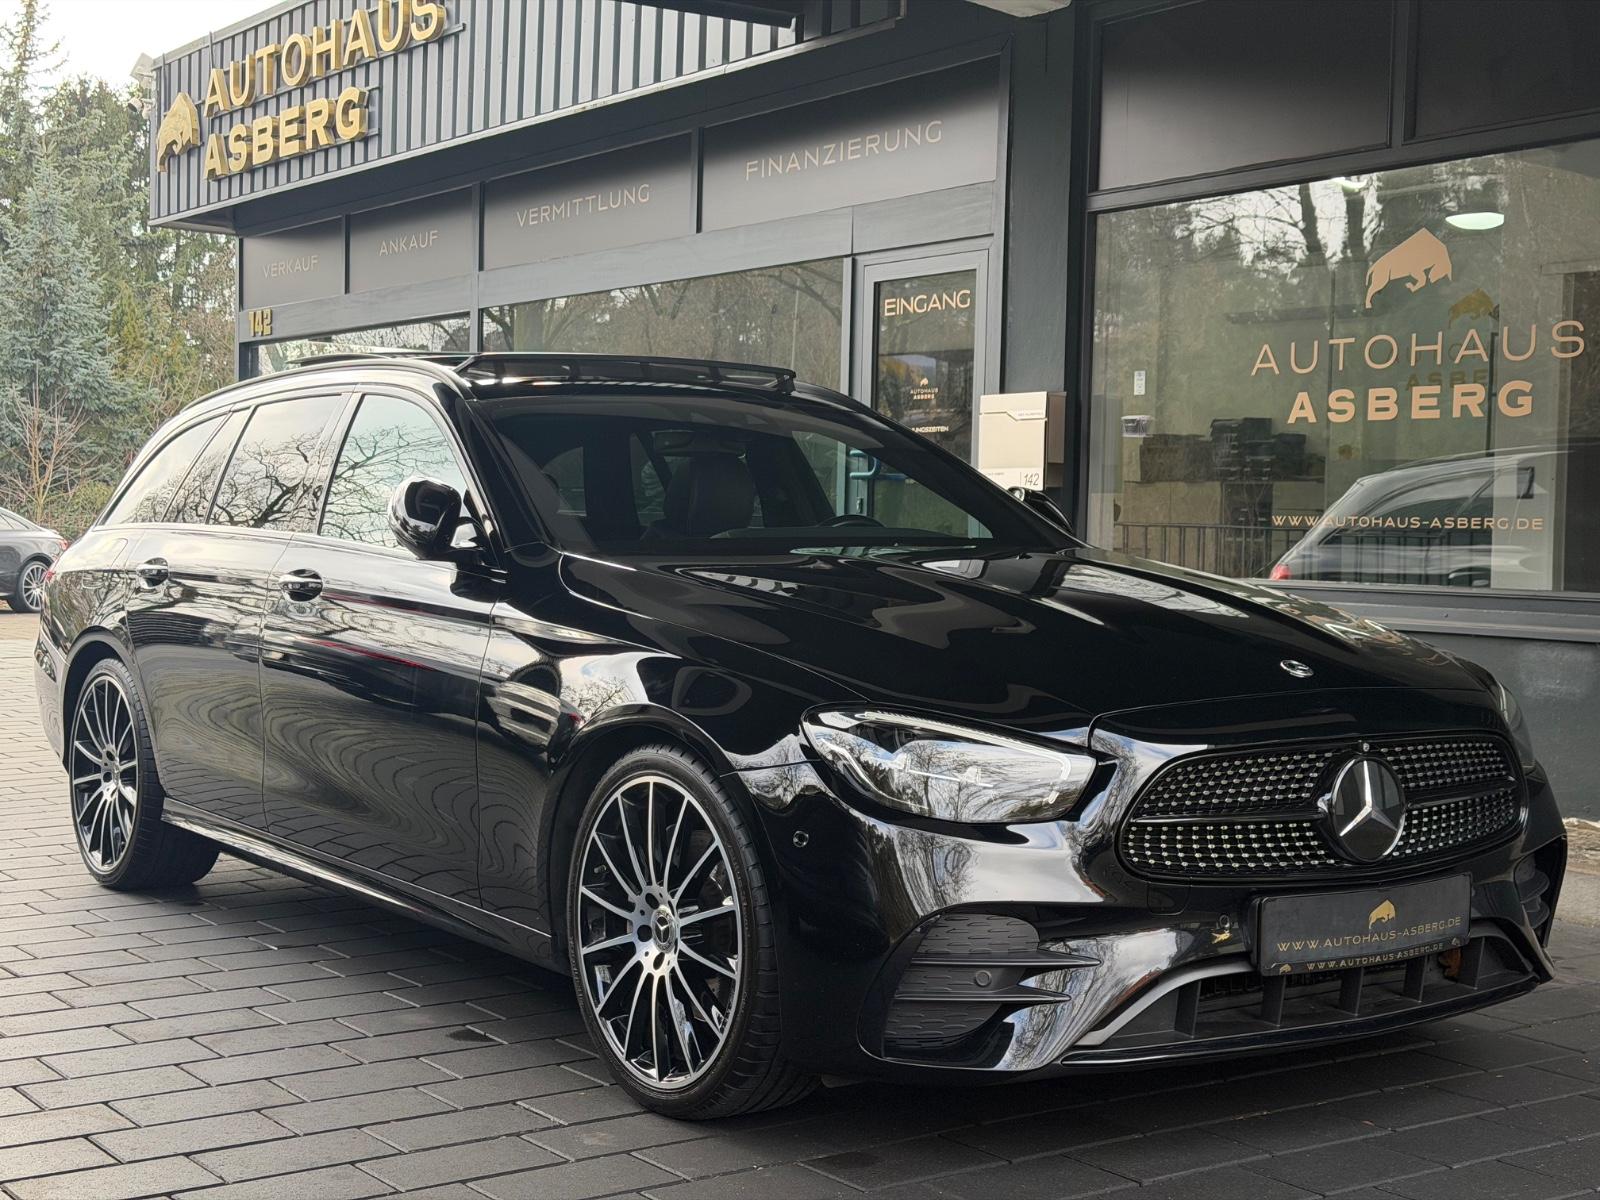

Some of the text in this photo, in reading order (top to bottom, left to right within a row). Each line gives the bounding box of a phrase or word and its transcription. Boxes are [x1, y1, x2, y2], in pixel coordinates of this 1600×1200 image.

[204, 0, 447, 118] AUTOHAUS
[203, 86, 370, 181] ASBERG
[745, 120, 944, 181] FINANZIERUNG
[516, 183, 651, 228] VERMITTLUNG
[378, 230, 439, 257] ANKAUF
[262, 255, 319, 279] VERKAUF
[883, 289, 972, 317] EINGANG
[248, 308, 273, 337] 142
[1250, 320, 1586, 378] AUTOHAUS
[1286, 380, 1535, 425] ASBERG
[912, 425, 949, 433] UNGSZEITEN
[1023, 472, 1040, 486] 142
[1271, 515, 1545, 531] WWW.AUTOHAUS-ASBERG.DE
[1277, 916, 1462, 952] WWW.AUTOHAUS-ASBERG.DE
